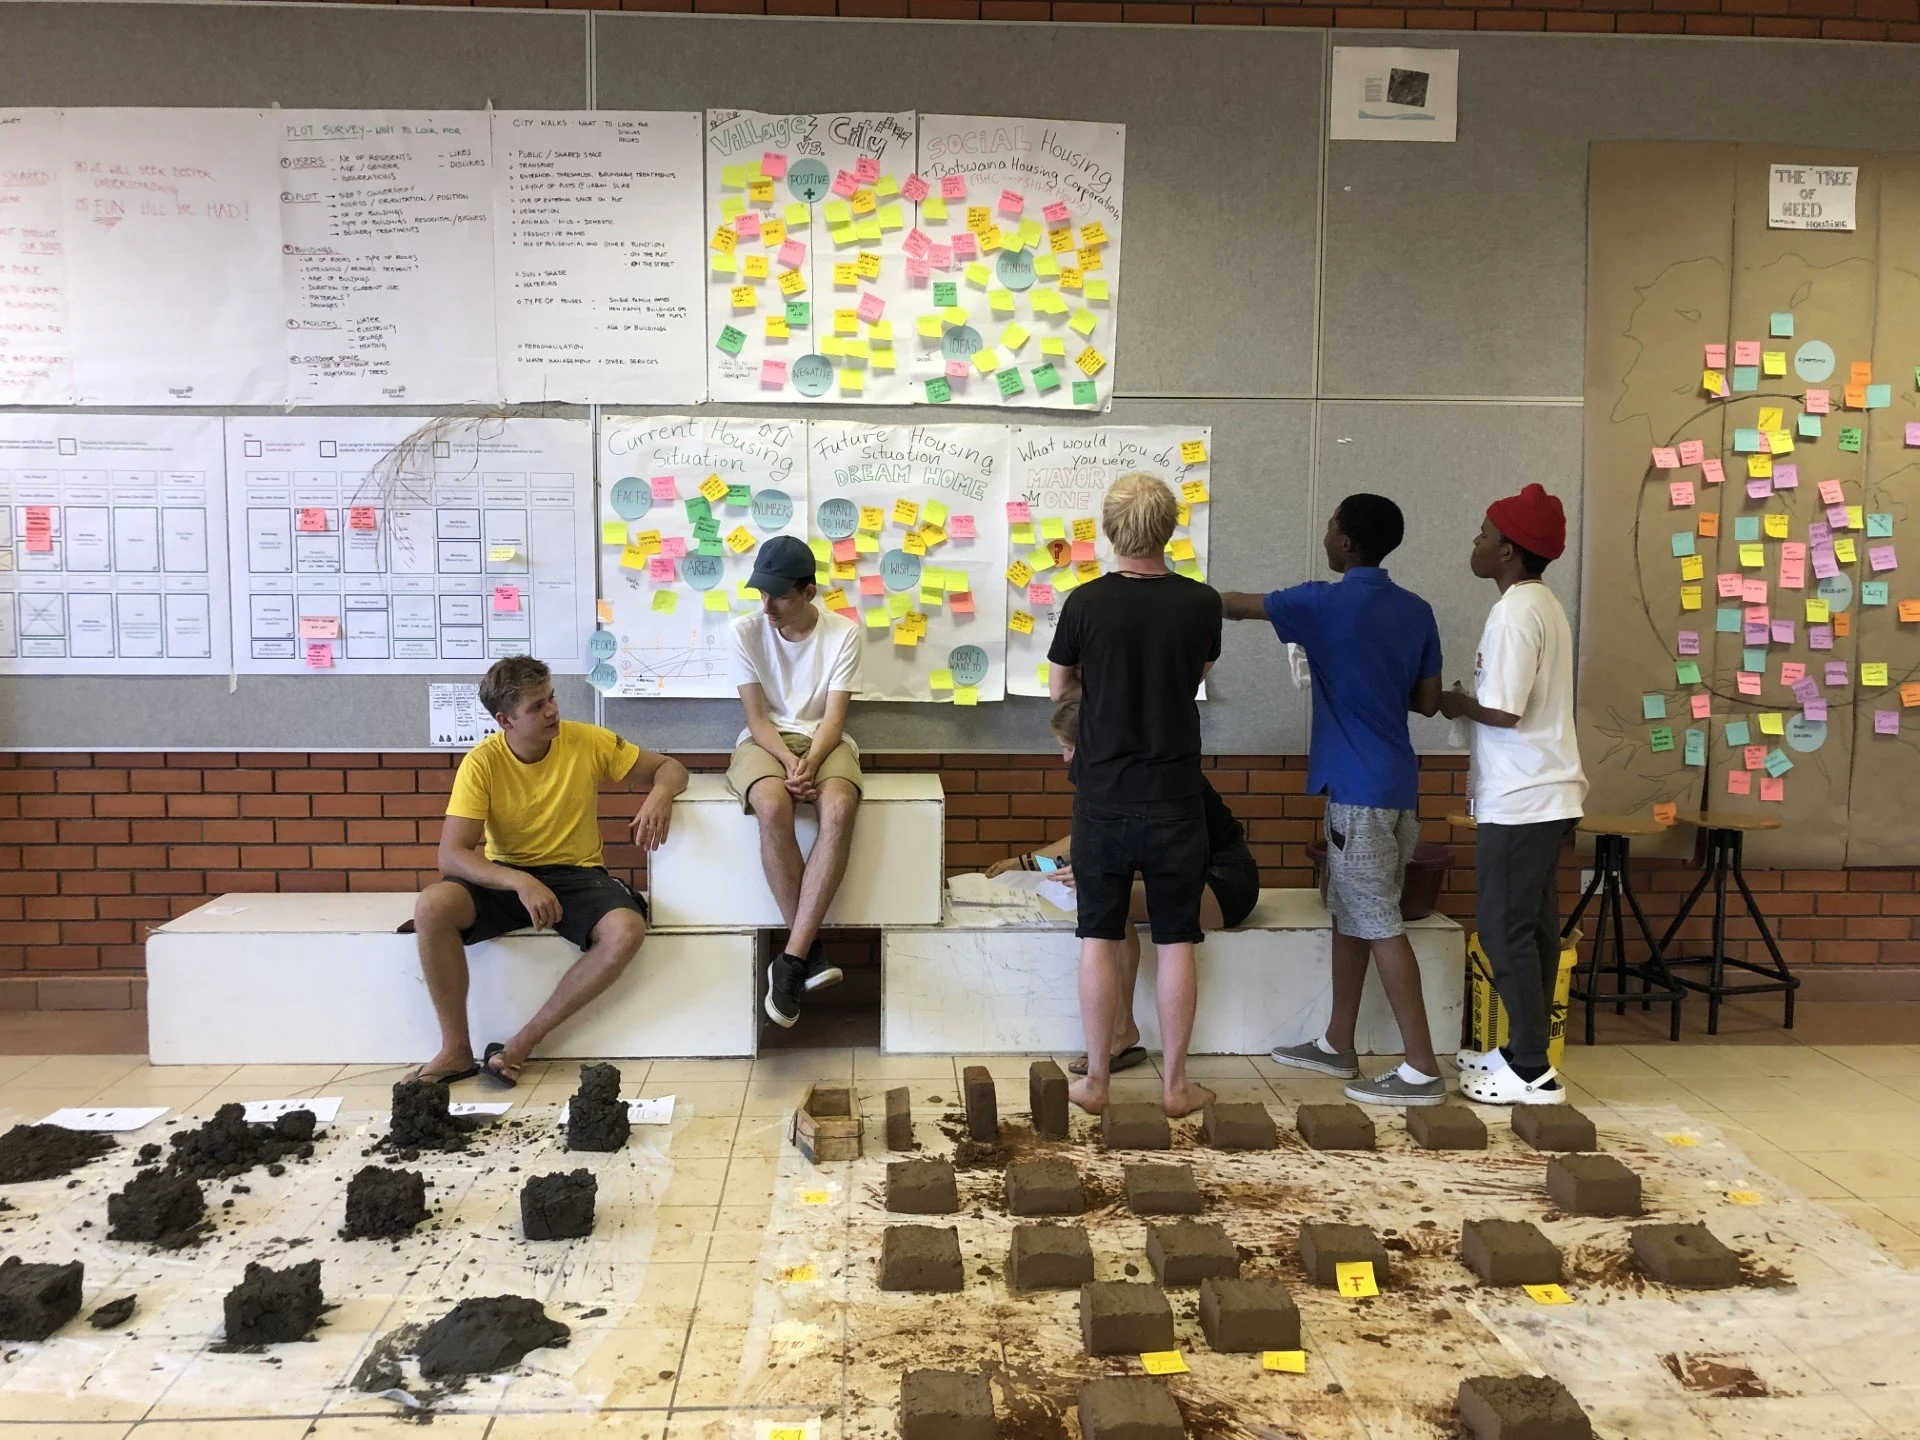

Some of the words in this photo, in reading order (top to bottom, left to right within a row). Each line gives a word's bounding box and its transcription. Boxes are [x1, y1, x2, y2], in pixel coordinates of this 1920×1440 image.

[286, 124, 313, 137] PLOT
[322, 124, 364, 140] SURVEY
[292, 156, 324, 166] USERS
[368, 152, 412, 161] RESIDENTS
[449, 148, 472, 158] LIKES
[450, 160, 486, 168] DISLIKES
[1041, 128, 1112, 194] Housing
[341, 172, 396, 181] GENERATIONS
[790, 172, 830, 186] POSITIVE
[932, 158, 1006, 180] Botswana
[1012, 157, 1058, 188] Housing
[1775, 170, 1806, 184] THE
[1816, 170, 1852, 186] TREE
[296, 192, 318, 200] PLOT
[436, 193, 469, 202] POSITION
[1800, 188, 1816, 200] OF
[1782, 202, 1823, 218] NEED
[1001, 262, 1032, 275] OPINION
[356, 324, 396, 334] ELECTRICITY
[949, 338, 977, 354] IDEAS
[792, 366, 832, 381] NEGATIVE
[608, 418, 698, 456] Current
[711, 418, 794, 482] Housing
[814, 430, 889, 460] Future
[911, 426, 994, 476] Housing
[860, 446, 940, 466] Situation
[1018, 437, 1056, 463] What
[1063, 433, 1106, 450] would
[1119, 440, 1148, 457] you
[1154, 446, 1174, 468] do
[654, 446, 746, 472] Situation
[1072, 454, 1096, 470] you
[1102, 456, 1138, 468] were
[834, 464, 912, 487] DREAM
[924, 466, 988, 501] HOME
[1027, 466, 1106, 489] MAYOR
[616, 490, 648, 505] FACTS
[1044, 490, 1090, 510] ONE
[754, 502, 793, 519] NUMBERS
[828, 506, 852, 517] WANT
[822, 520, 833, 529] TO
[835, 518, 854, 530] HAVE
[686, 560, 716, 576] AREA
[590, 640, 616, 653] PEOPLE
[955, 648, 980, 663] DON'T
[592, 666, 617, 682] ROOMS
[950, 662, 970, 672] WANT
[972, 662, 982, 672] TO
